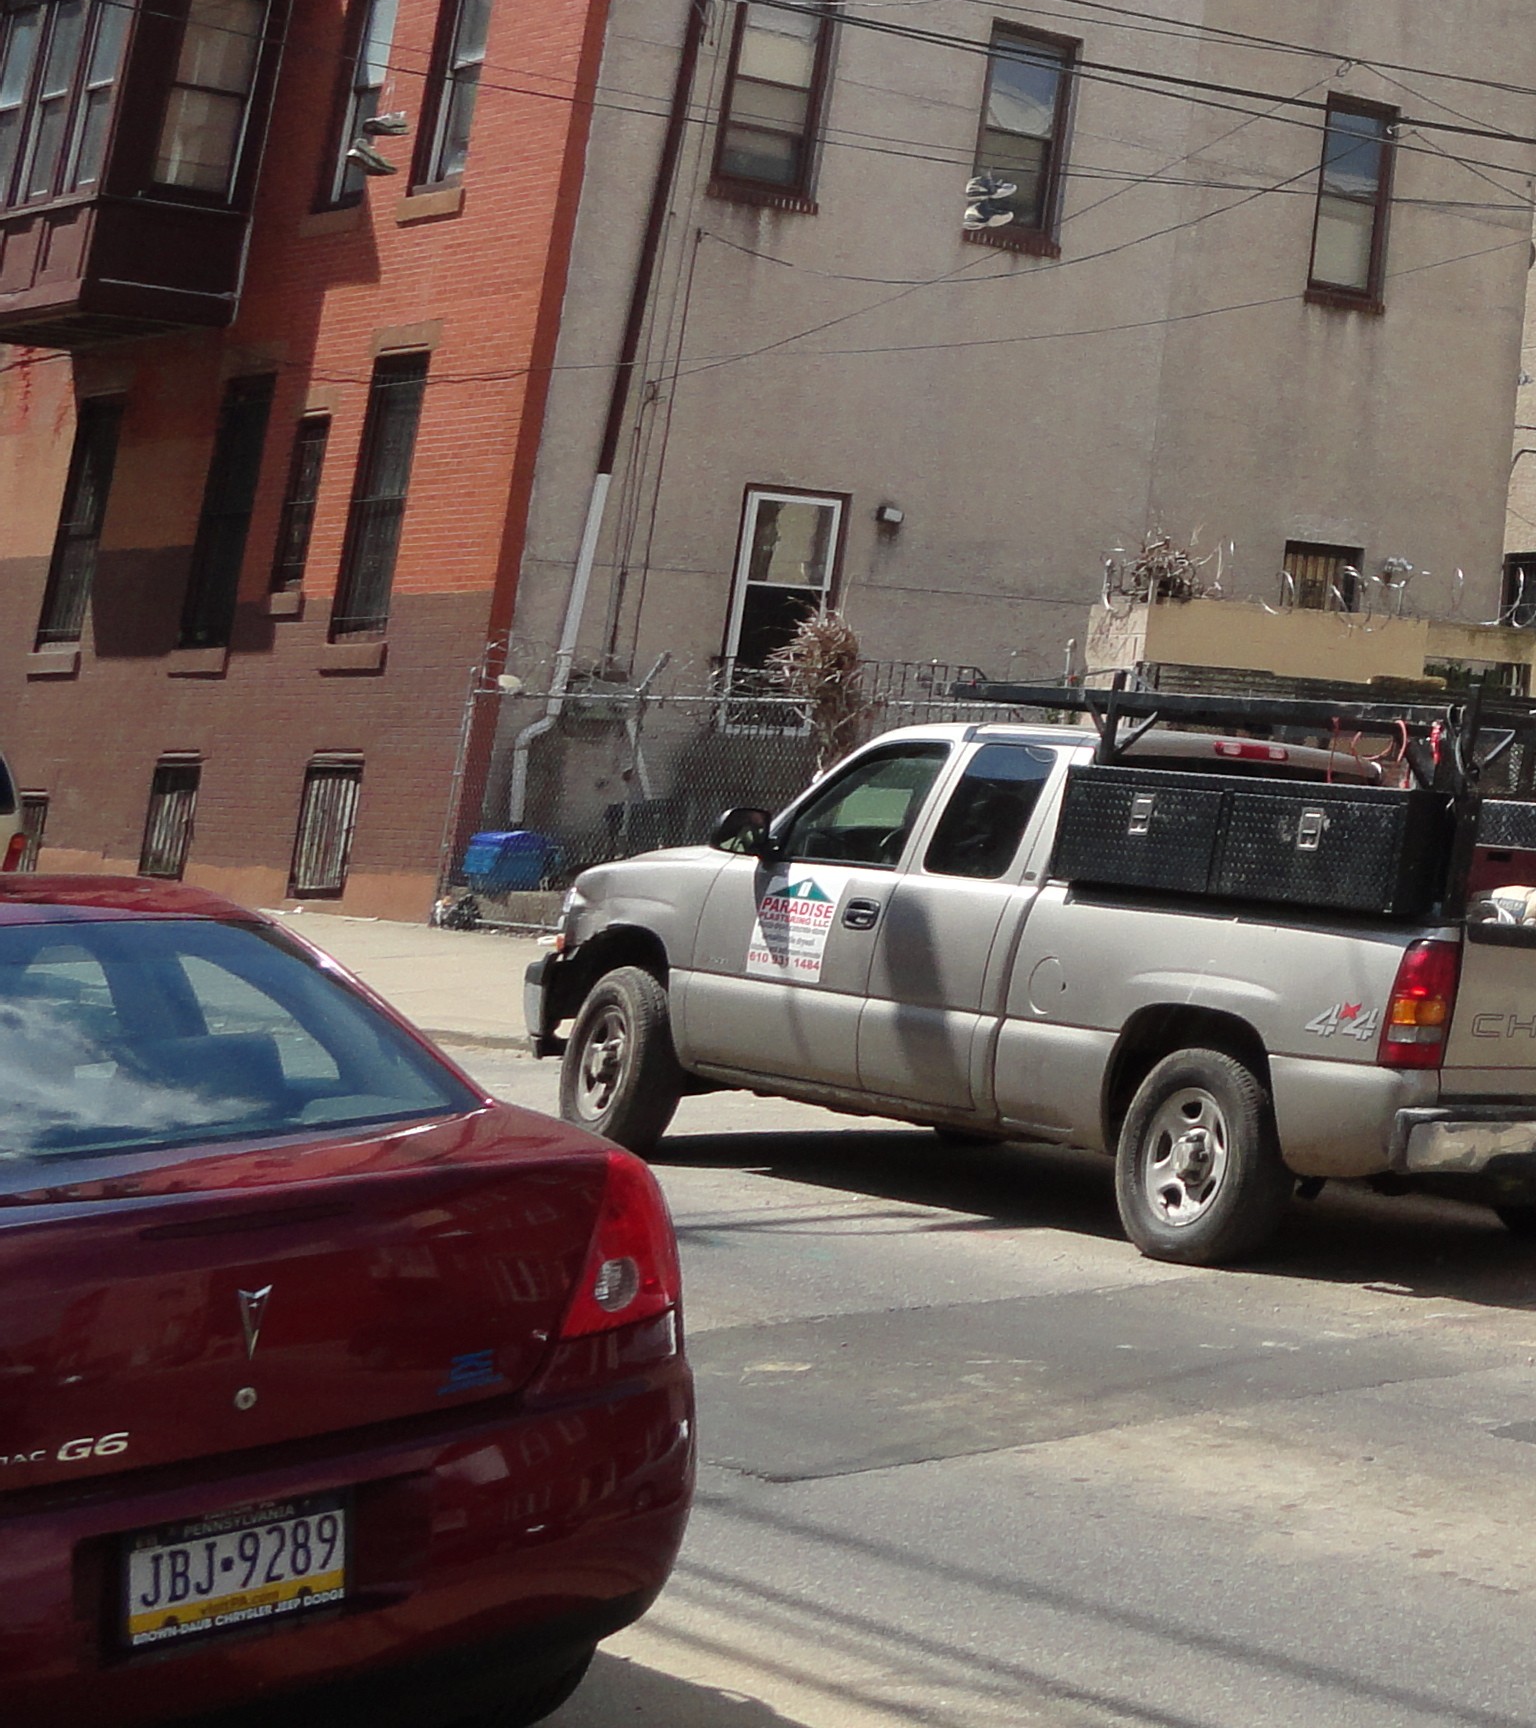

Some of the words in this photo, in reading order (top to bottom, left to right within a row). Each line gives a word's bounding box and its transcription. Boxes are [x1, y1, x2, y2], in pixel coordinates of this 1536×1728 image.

[761, 897, 835, 919] PARADISE
[812, 918, 830, 928] LLC
[749, 951, 768, 964] 610
[794, 957, 820, 971] 1484
[57, 1431, 129, 1461] G6
[183, 1503, 296, 1538] PENNSYLVANIA
[132, 1616, 213, 1647] BROWN-DAUB
[215, 1603, 273, 1627] CHRYSLER
[274, 1596, 301, 1614] JEEP
[303, 1587, 346, 1608] DODGE
